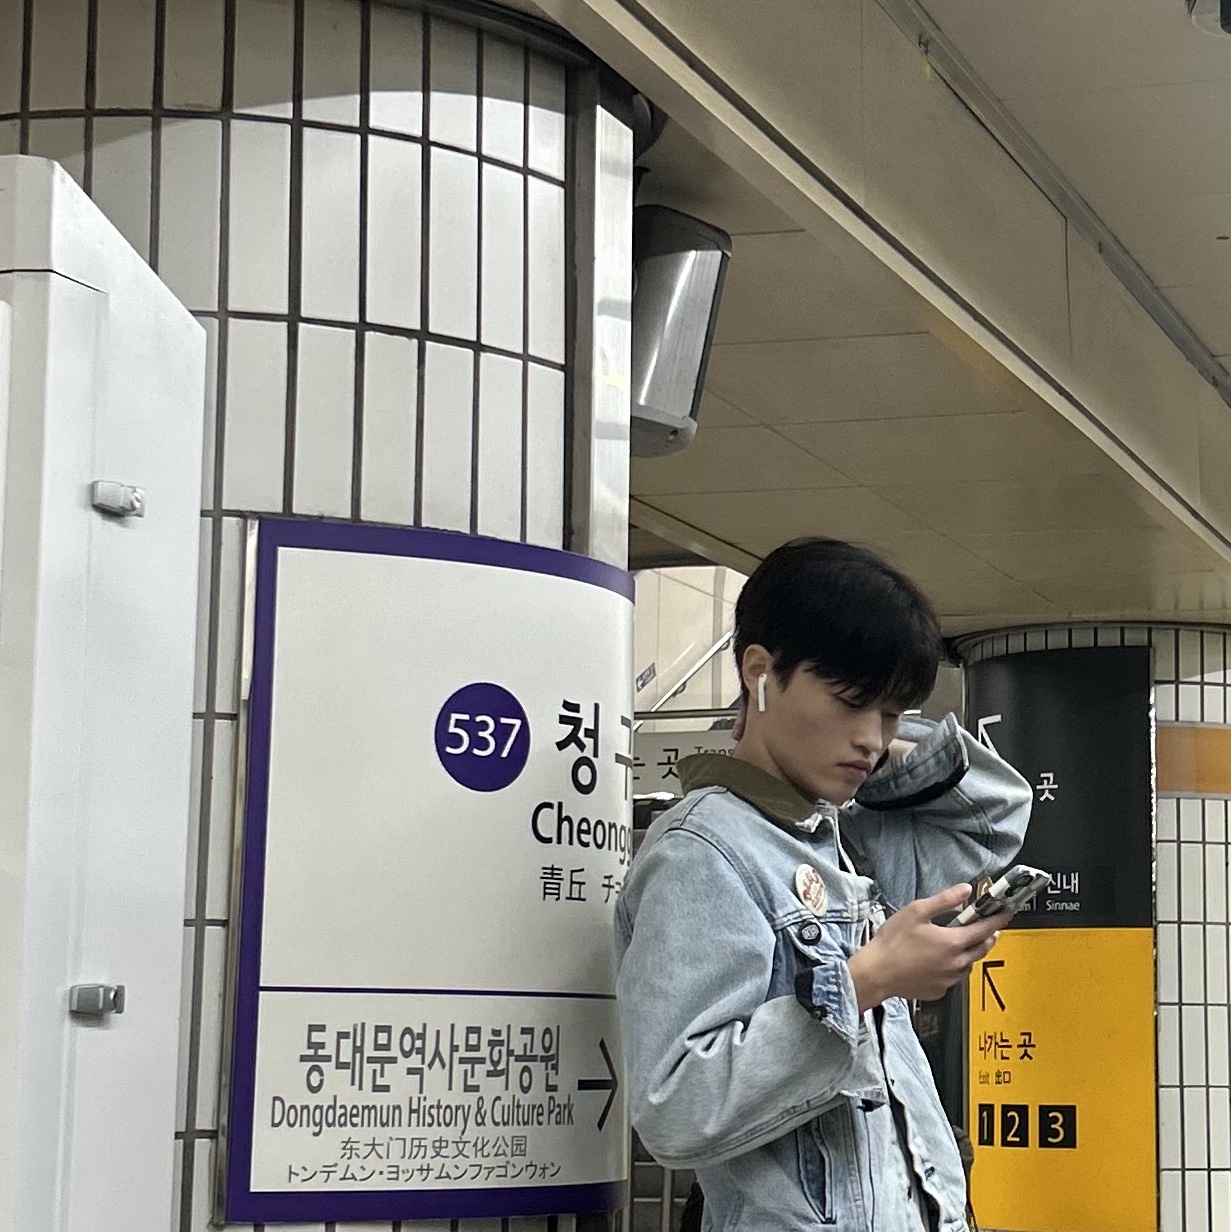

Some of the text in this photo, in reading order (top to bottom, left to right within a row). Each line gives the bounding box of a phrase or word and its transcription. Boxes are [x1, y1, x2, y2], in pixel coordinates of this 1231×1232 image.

[445, 713, 522, 759] 537
[1036, 772, 1059, 802] 곳
[540, 864, 587, 902] 青丘
[1045, 900, 1081, 912] Sinnae
[299, 1022, 561, 1095] 동대문역사문화공원
[978, 1031, 1037, 1061] 나가는 곳
[270, 1094, 575, 1137] Dongdaemun History & Culture Park
[1006, 1110, 1021, 1142] 2
[1047, 1111, 1065, 1144] 3
[340, 1135, 528, 1160] 东大门历史文化公园
[287, 1160, 562, 1184] トンデムン・ヨッサムンファゴンウォン
